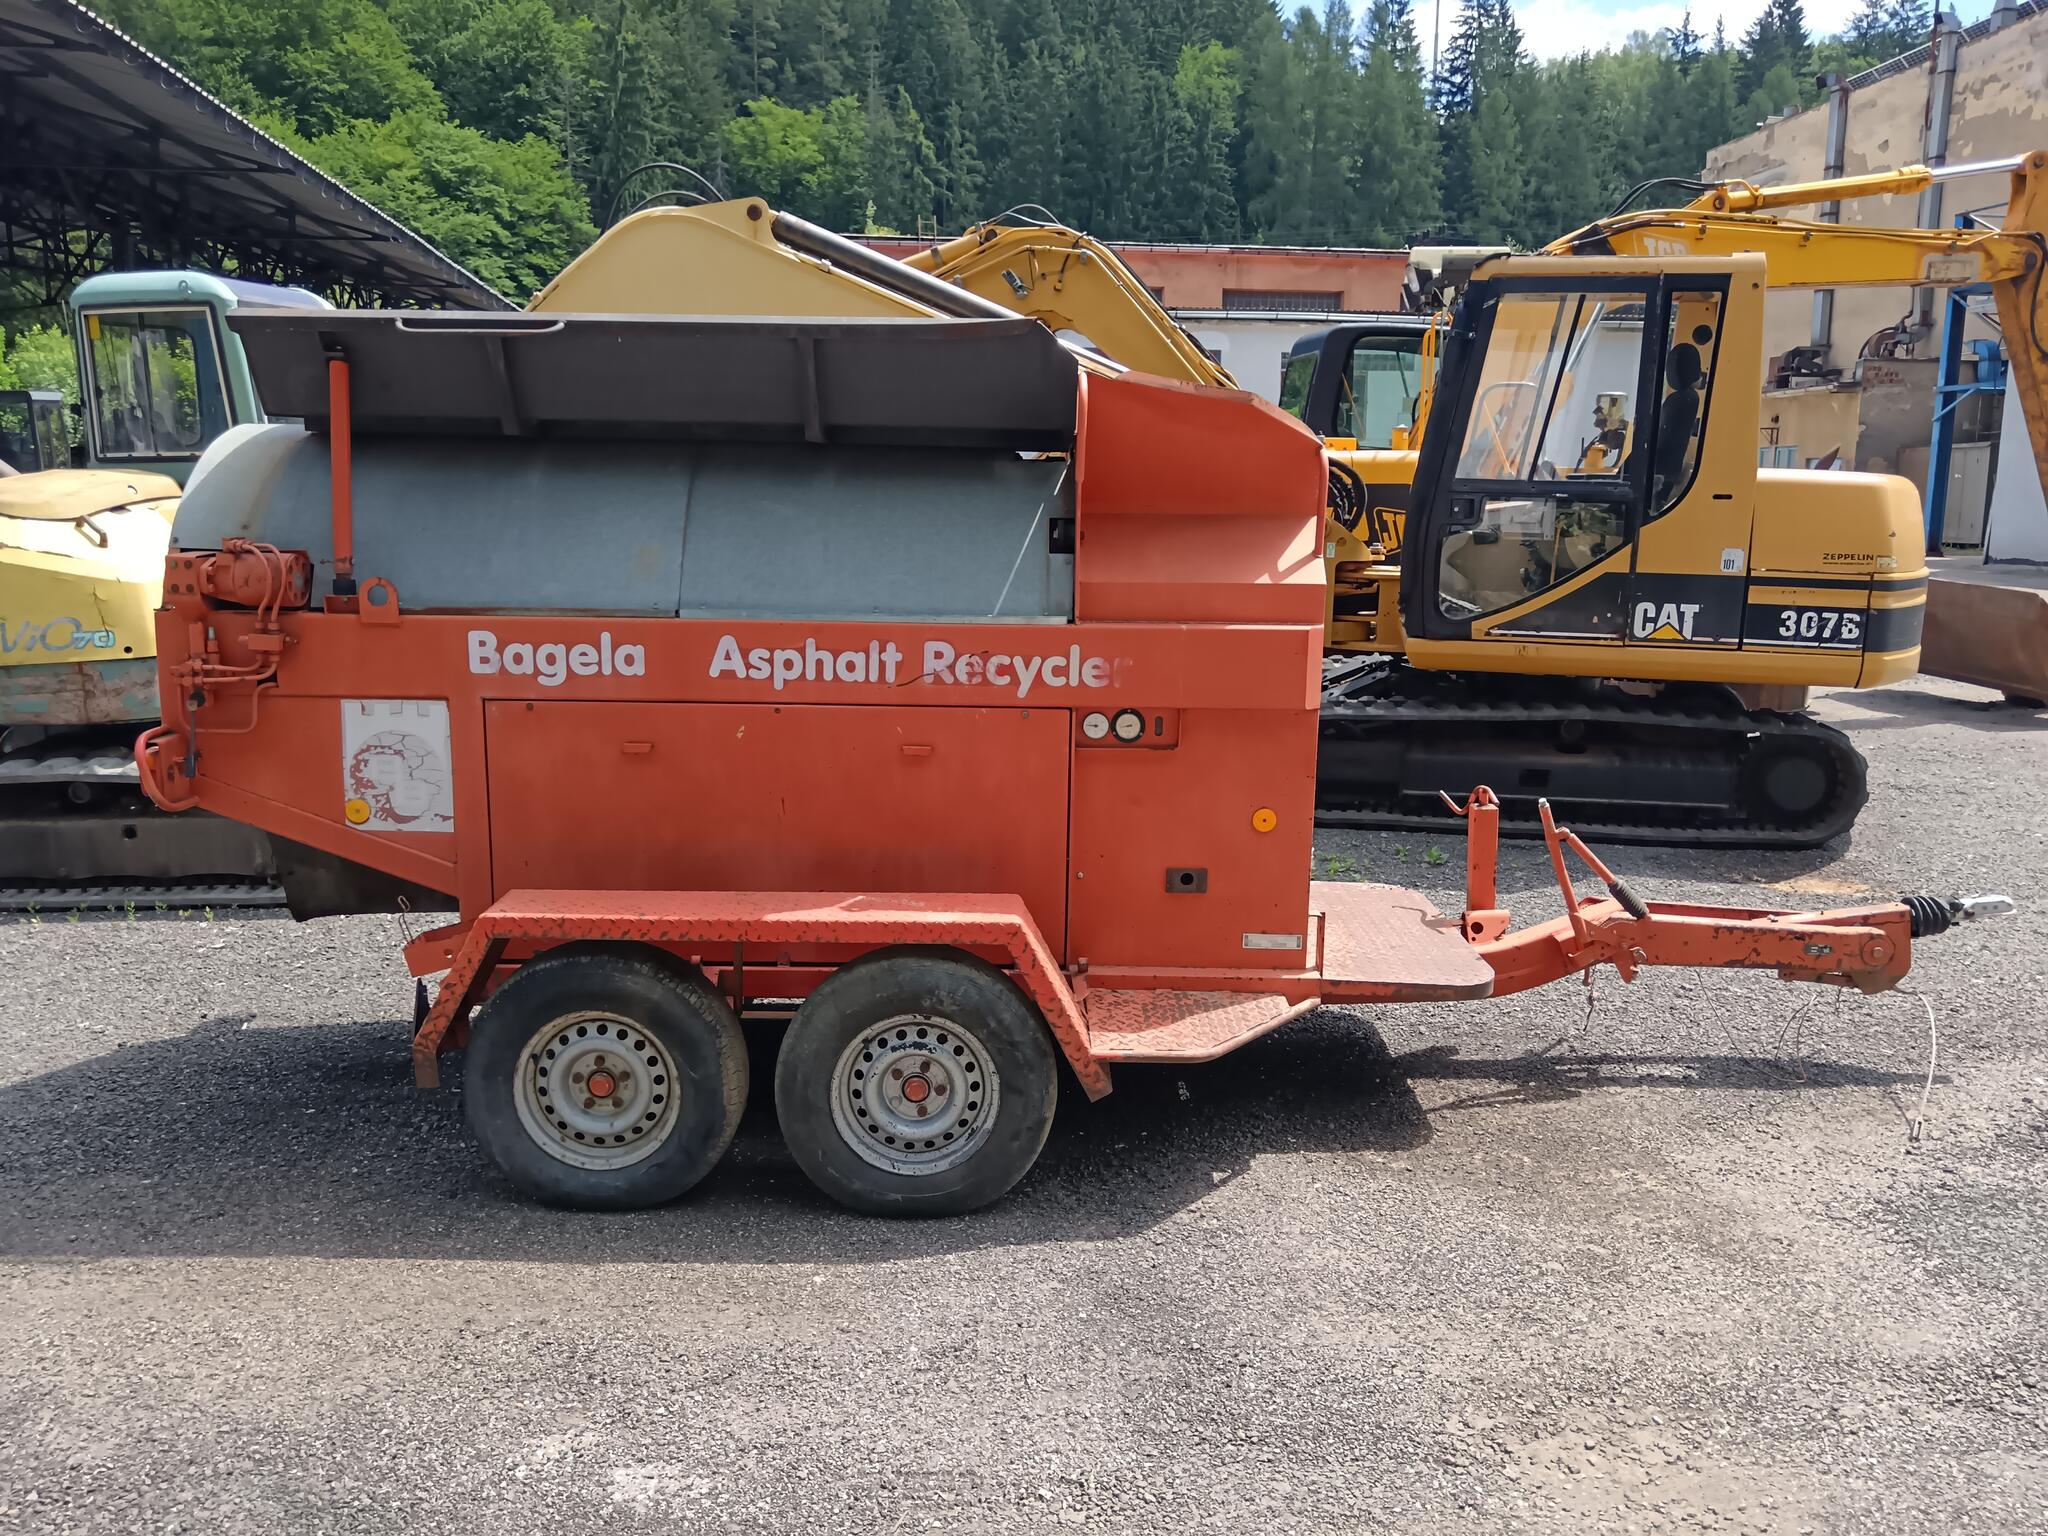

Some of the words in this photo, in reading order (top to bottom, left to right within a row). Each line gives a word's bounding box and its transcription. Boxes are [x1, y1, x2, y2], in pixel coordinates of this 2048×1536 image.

[1723, 559, 1735, 570] 101
[1822, 553, 1874, 561] ZEPPELIN
[1633, 602, 1700, 640] CAT
[1778, 610, 1861, 640] 307B
[467, 630, 646, 687] Bagela
[708, 635, 903, 690] Asphalt
